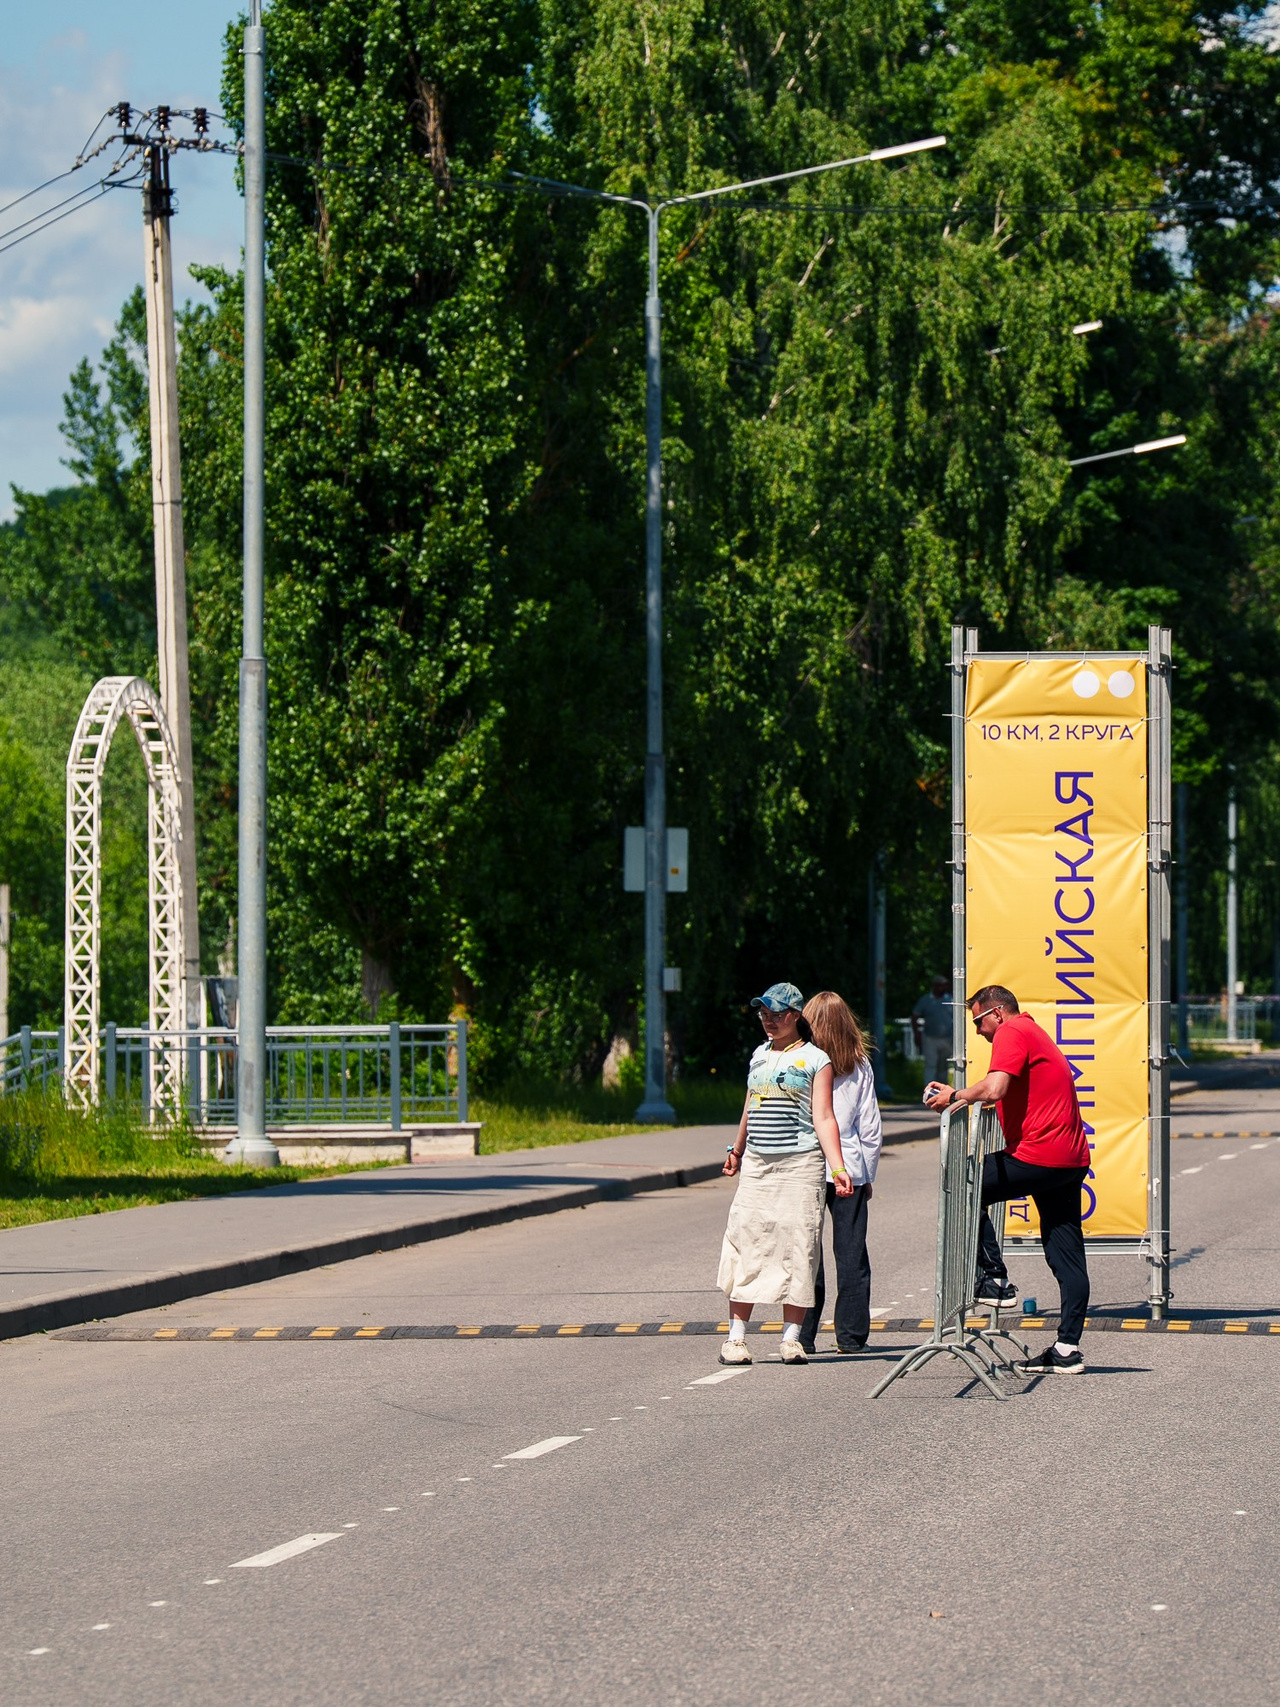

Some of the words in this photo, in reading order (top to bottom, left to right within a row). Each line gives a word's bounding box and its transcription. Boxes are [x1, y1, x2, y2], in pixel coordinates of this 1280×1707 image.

[981, 724, 1001, 740] 10
[1007, 724, 1044, 742] КМ,
[1048, 724, 1060, 740] 2
[1066, 724, 1134, 741] КРУГА
[1045, 771, 1097, 1222] МПИЙСКАЯ
